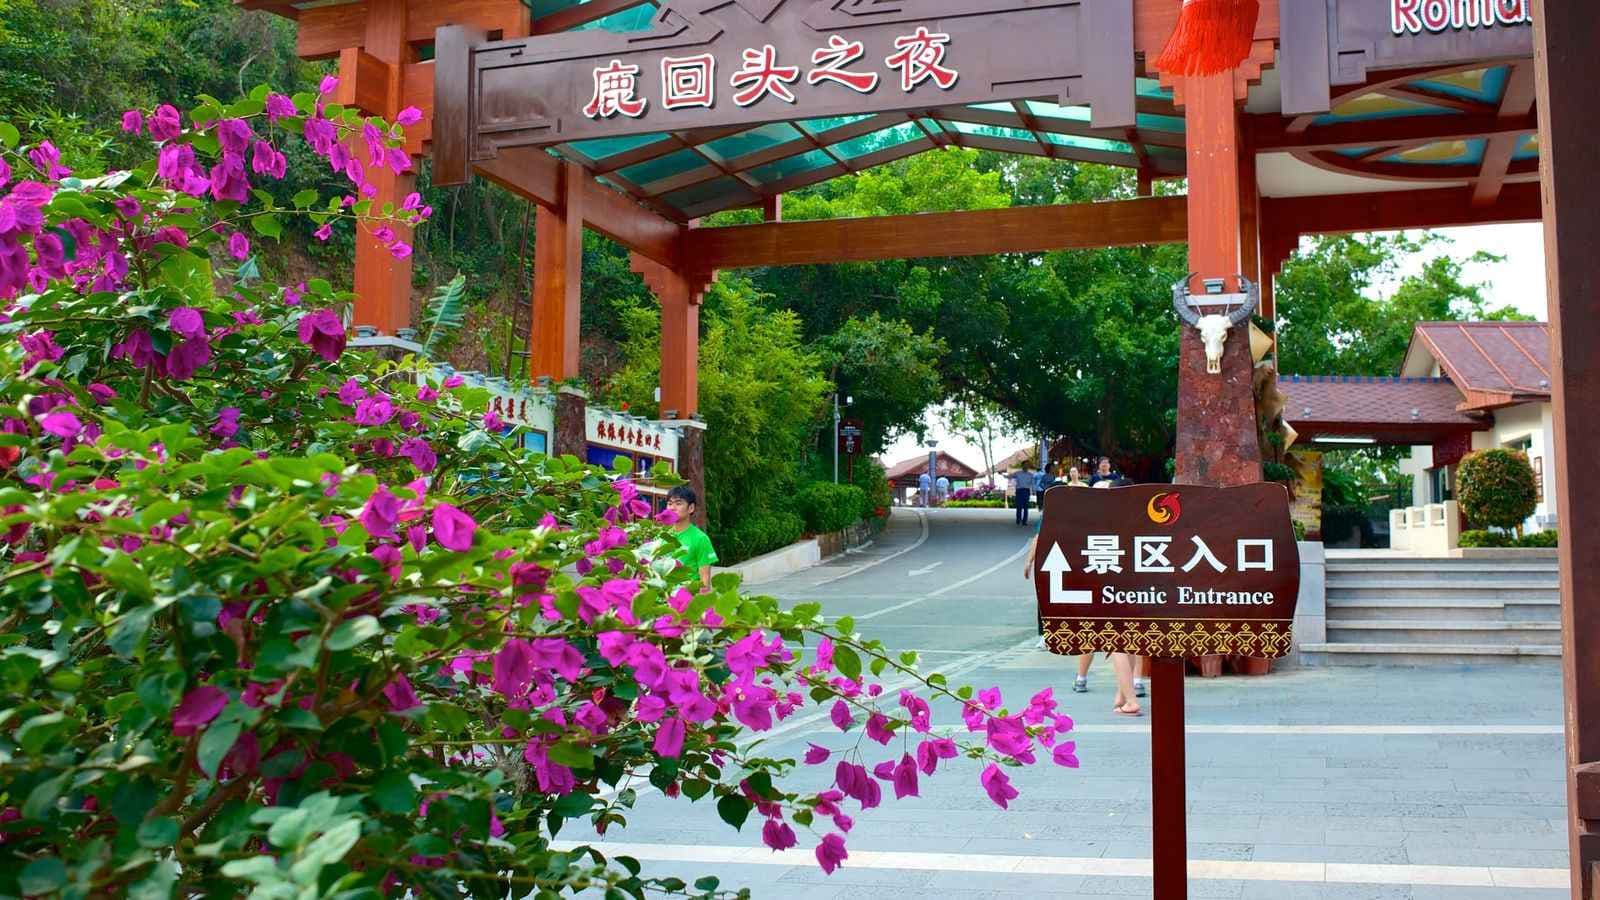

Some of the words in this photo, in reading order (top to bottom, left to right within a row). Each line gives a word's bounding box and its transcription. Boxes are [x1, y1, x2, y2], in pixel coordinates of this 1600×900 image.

[1390, 0, 1533, 34] Roma
[582, 26, 959, 118] 鹿回头之夜
[1081, 535, 1274, 574] 景区入口
[1102, 586, 1167, 605] Scenic
[1177, 586, 1275, 606] Entrance
